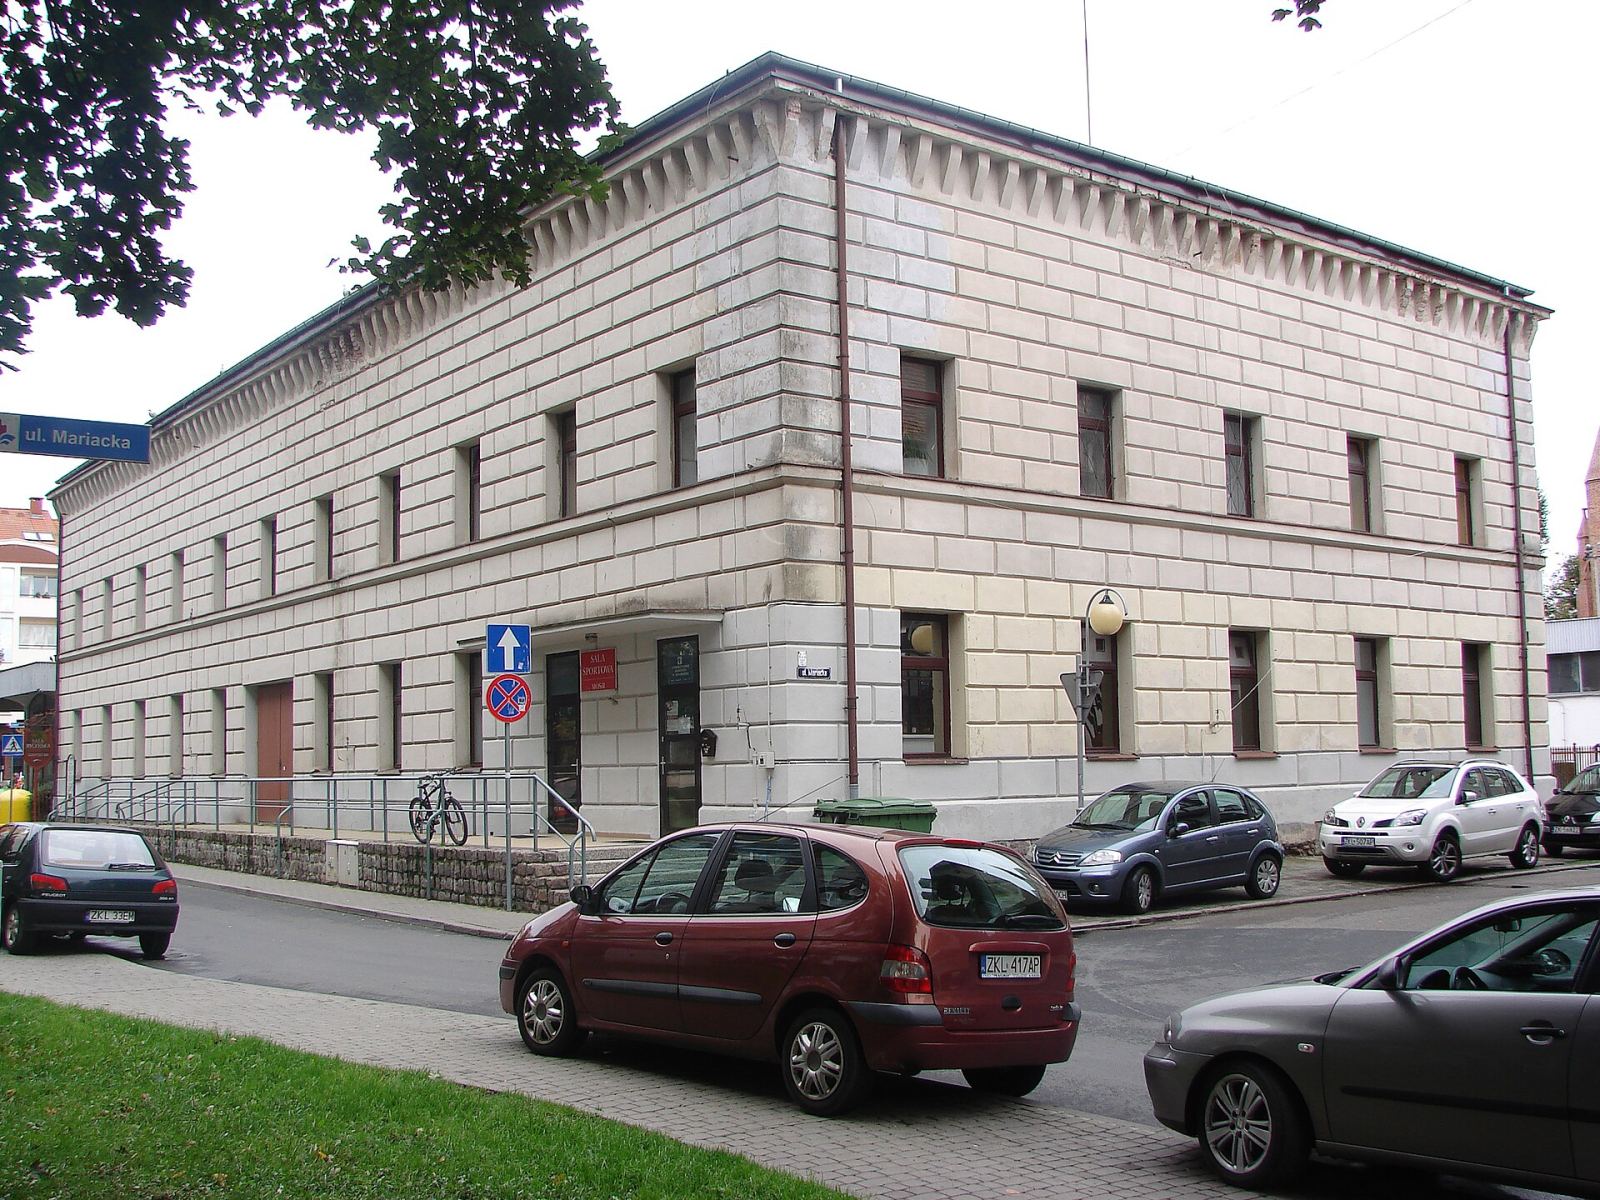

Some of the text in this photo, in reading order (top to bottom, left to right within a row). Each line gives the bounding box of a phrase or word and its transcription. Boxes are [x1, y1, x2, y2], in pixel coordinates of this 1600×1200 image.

[25, 427, 132, 449] ul. Mariacka
[590, 654, 606, 663] SALA
[582, 664, 614, 676] SPORTOWA
[90, 910, 110, 921] ZKL
[987, 956, 1040, 973] ZKL 417AP
